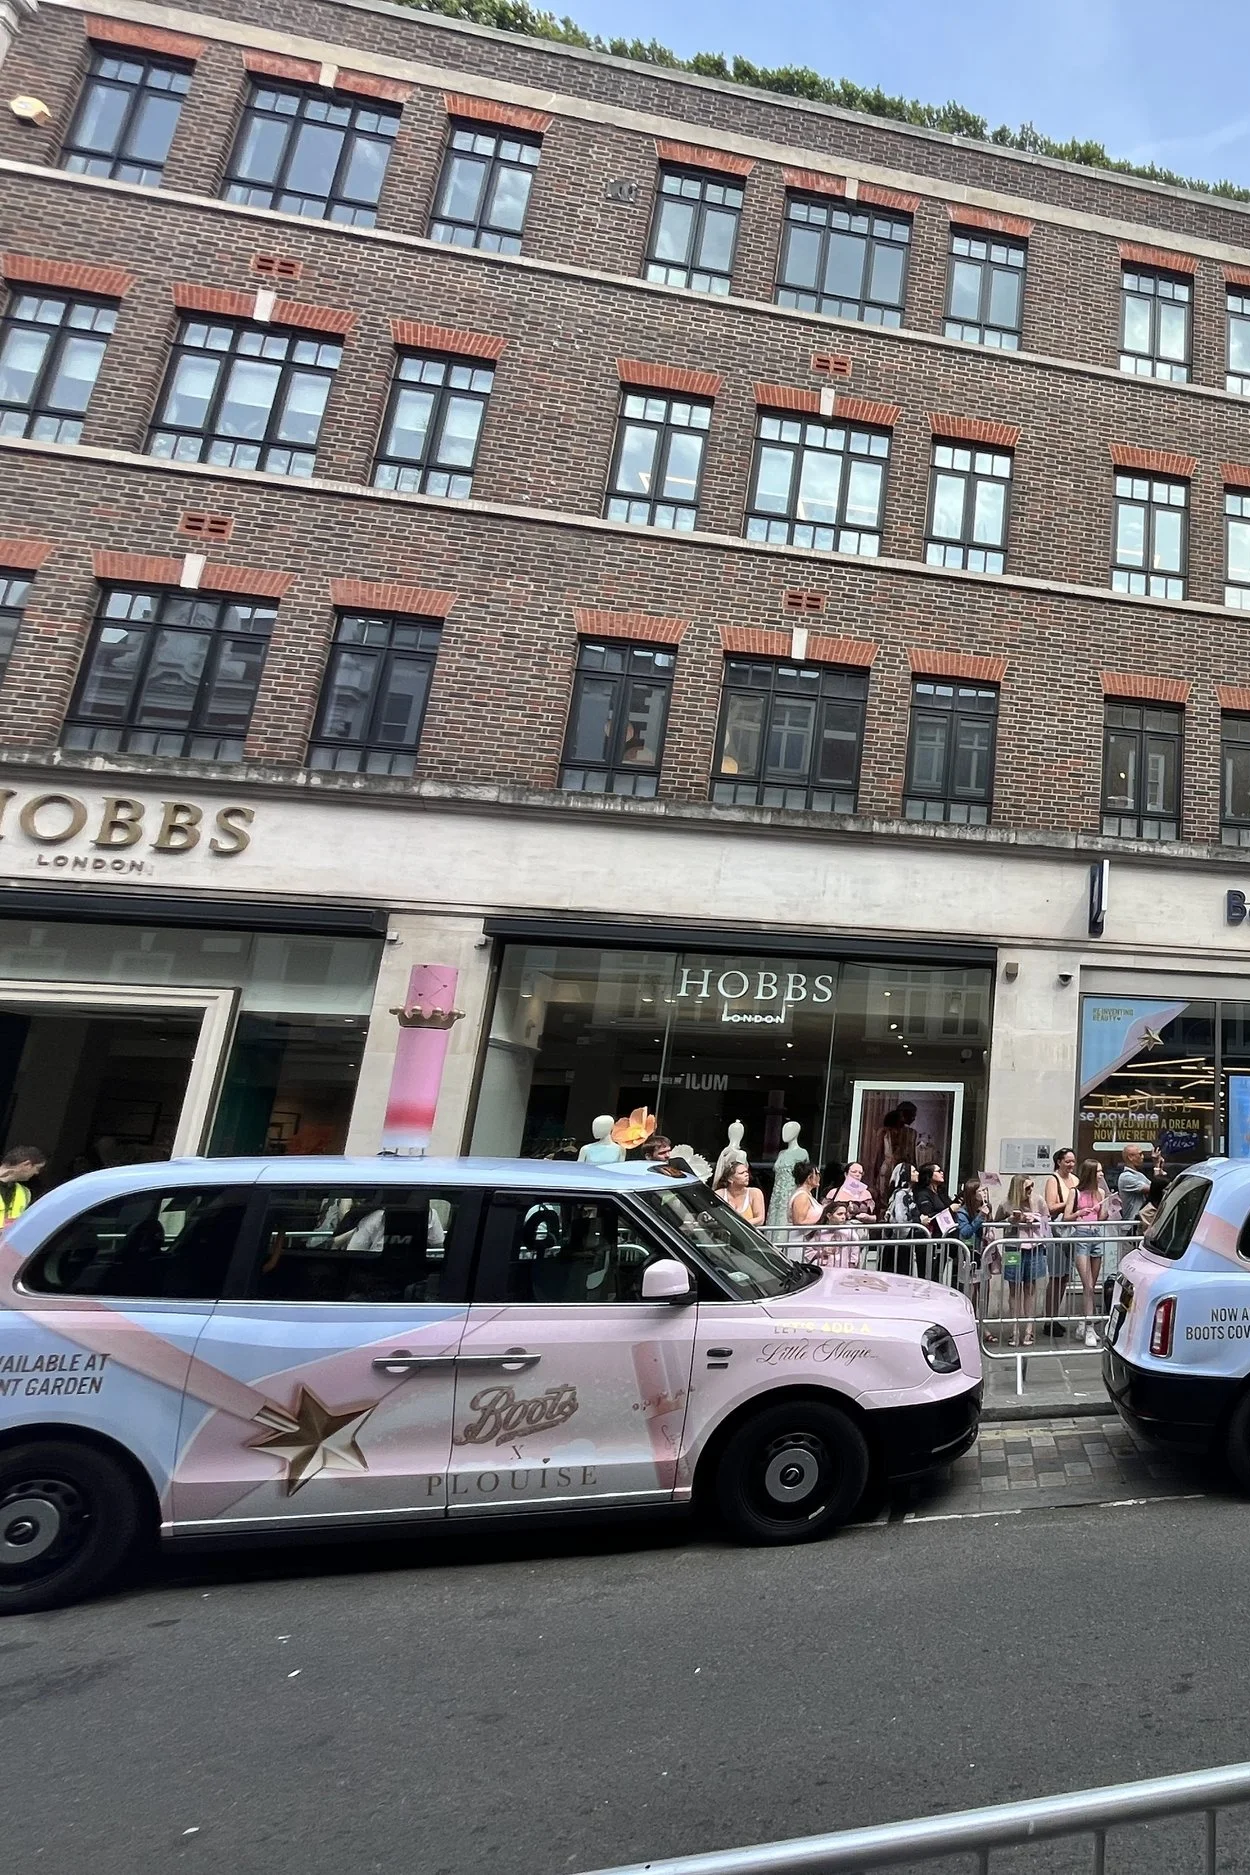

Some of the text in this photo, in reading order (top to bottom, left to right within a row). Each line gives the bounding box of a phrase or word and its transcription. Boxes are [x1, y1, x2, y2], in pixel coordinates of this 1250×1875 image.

[37, 854, 145, 873] LONDON
[677, 968, 833, 1003] HOBBS
[721, 1012, 785, 1024] LONDON
[1094, 1119, 1200, 1130] STARTED WITH A DREAM
[1129, 1110, 1159, 1121] here
[1093, 1129, 1157, 1140] NOW WE'RE IN
[1211, 1307, 1238, 1322] NOW
[1186, 1325, 1225, 1341] BOOTS
[756, 1338, 810, 1366] Little
[84, 1353, 110, 1371] AT
[25, 1376, 103, 1396] GARDEN
[453, 1384, 579, 1447] Boots
[426, 1465, 598, 1497] PLOUISE
